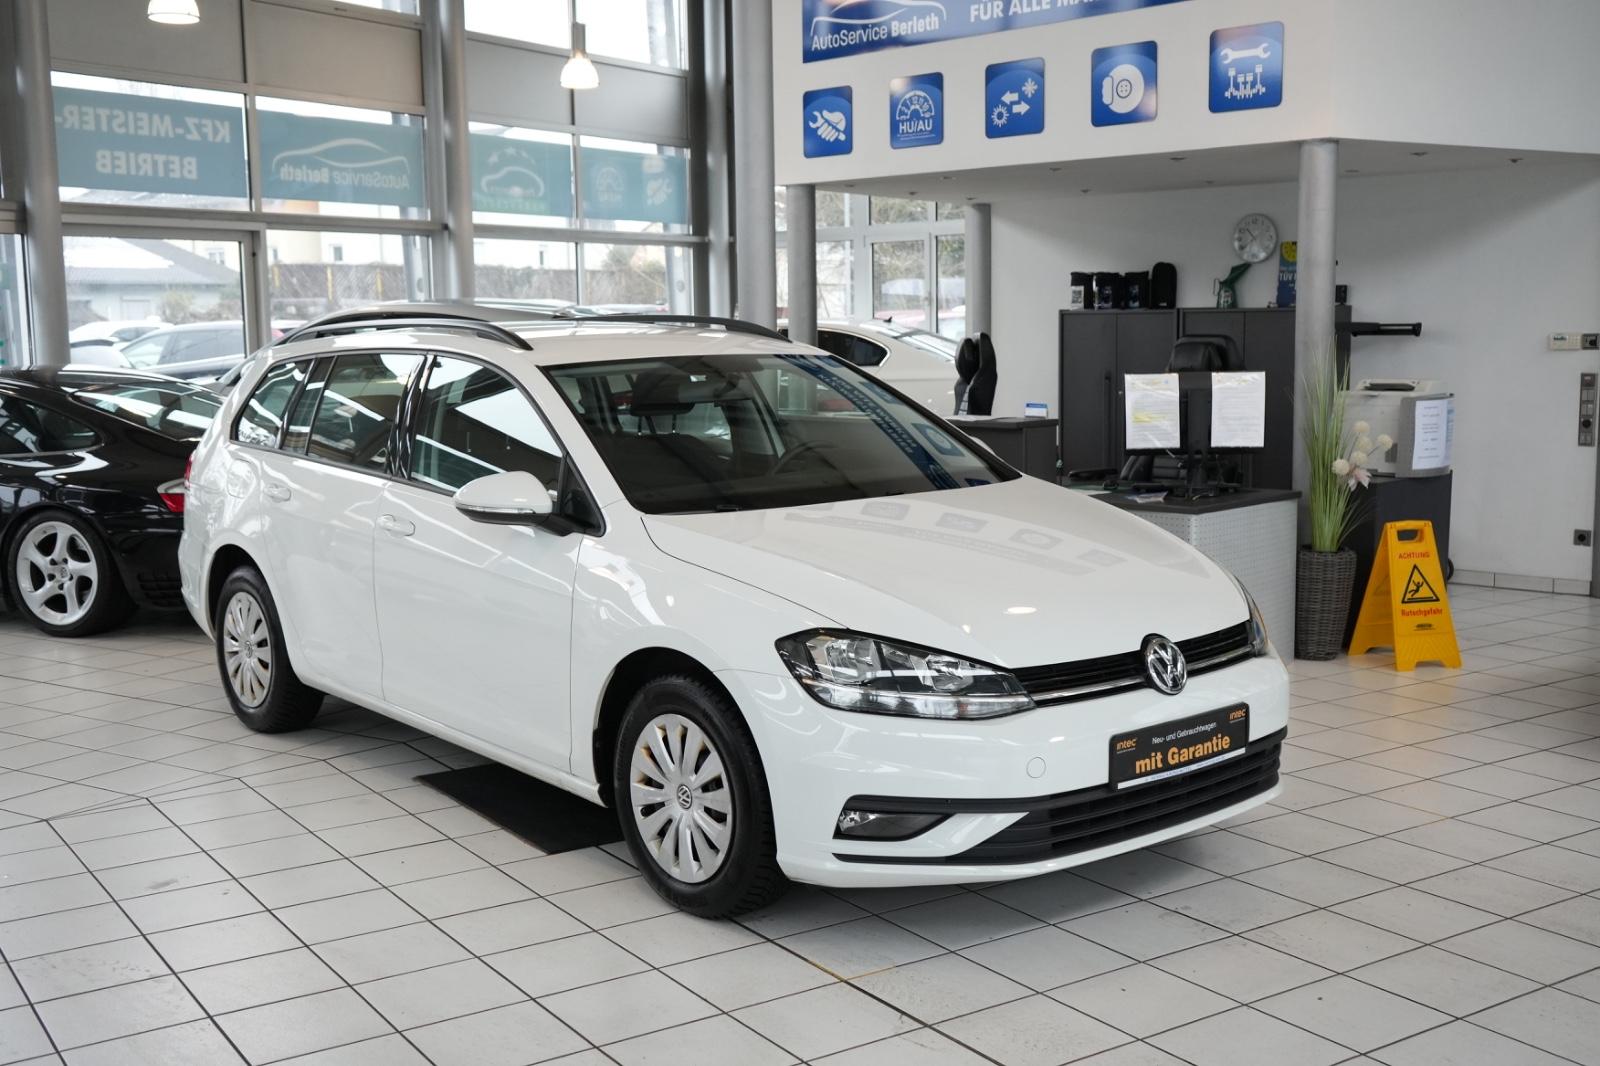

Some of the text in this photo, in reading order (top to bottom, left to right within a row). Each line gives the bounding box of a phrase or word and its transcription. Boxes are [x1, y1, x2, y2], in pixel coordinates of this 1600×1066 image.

[970, 0, 1004, 22] FÜR
[811, 13, 939, 51] AutoService Berleth
[899, 118, 933, 134] HU/AU
[1398, 551, 1430, 560] ACHTUNG
[1135, 750, 1163, 774] mit
[1167, 733, 1231, 765] Garantie
